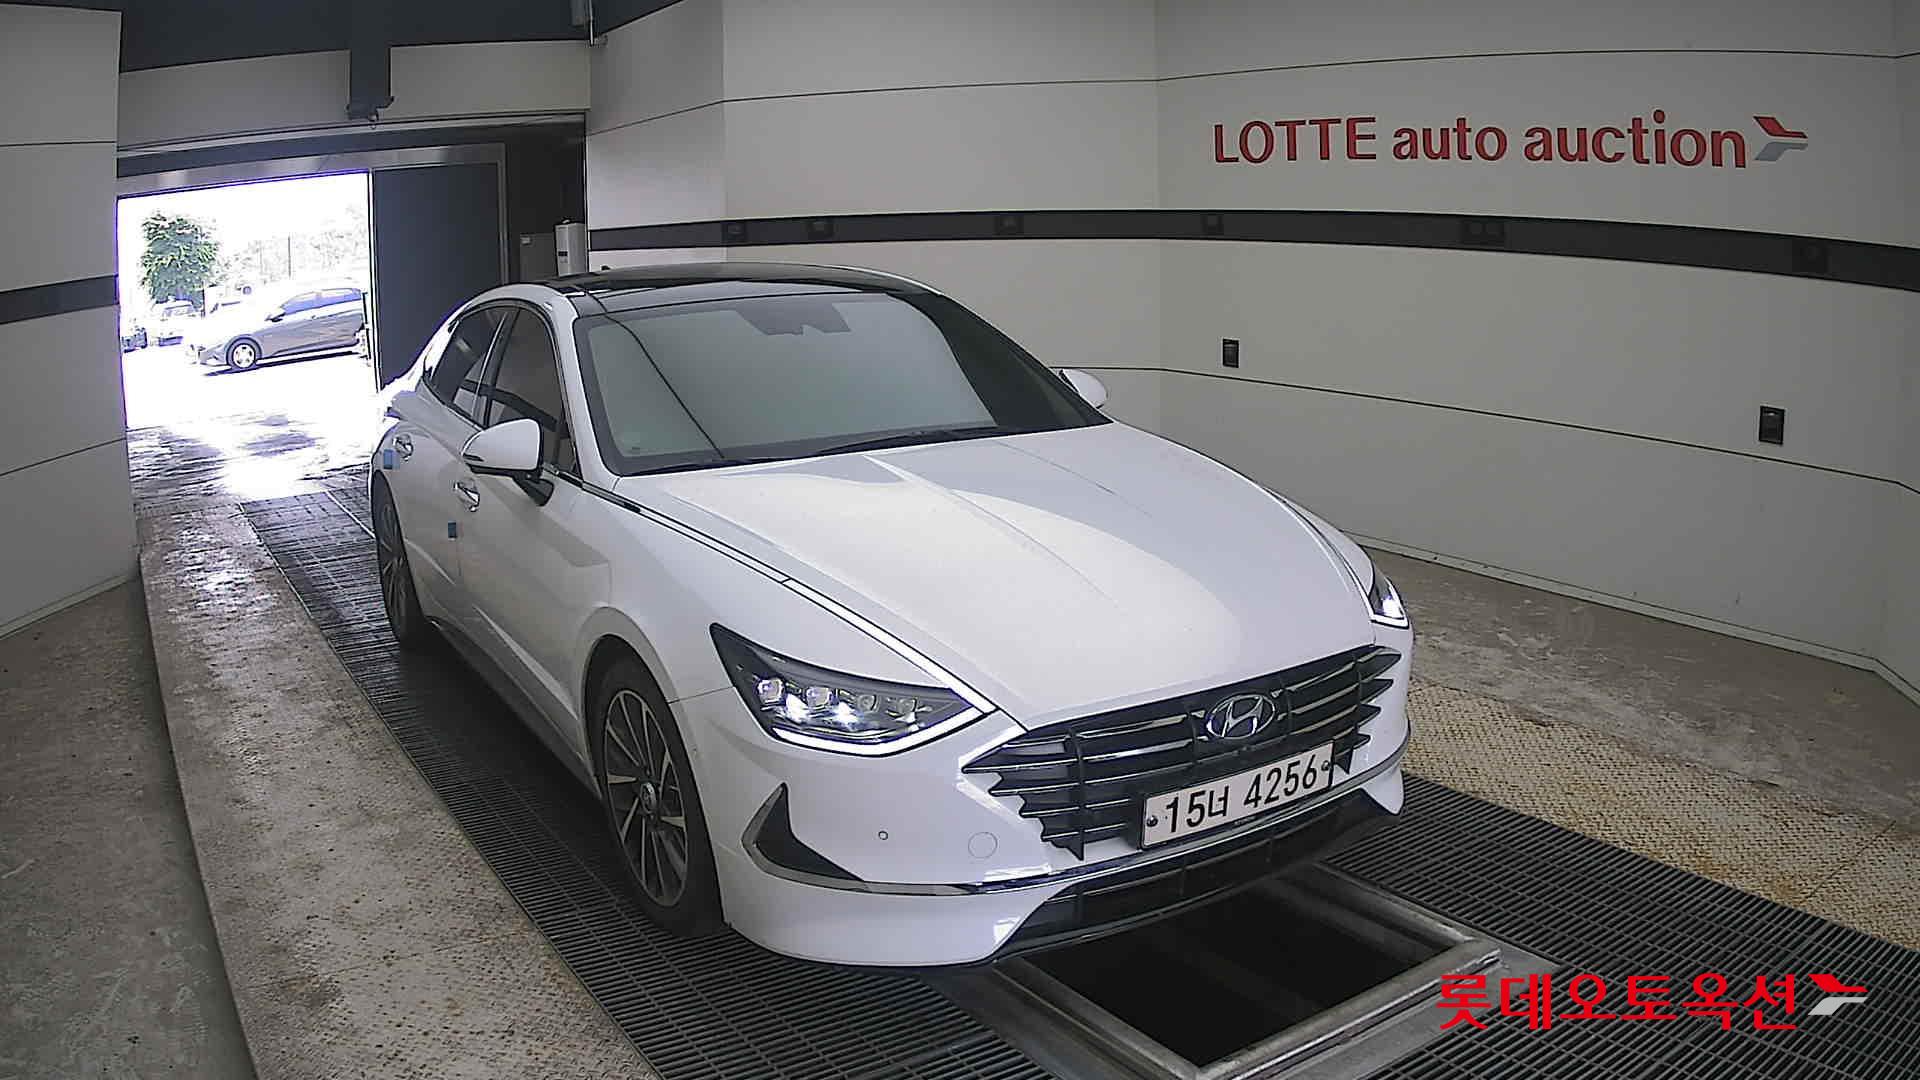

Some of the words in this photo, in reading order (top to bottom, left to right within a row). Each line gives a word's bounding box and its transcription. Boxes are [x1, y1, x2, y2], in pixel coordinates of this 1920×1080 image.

[1213, 117, 1377, 163] LOTTE
[1392, 117, 1508, 162] auto
[1523, 109, 1747, 168] auction
[1166, 785, 1230, 833] 15너
[1243, 753, 1318, 808] 4256
